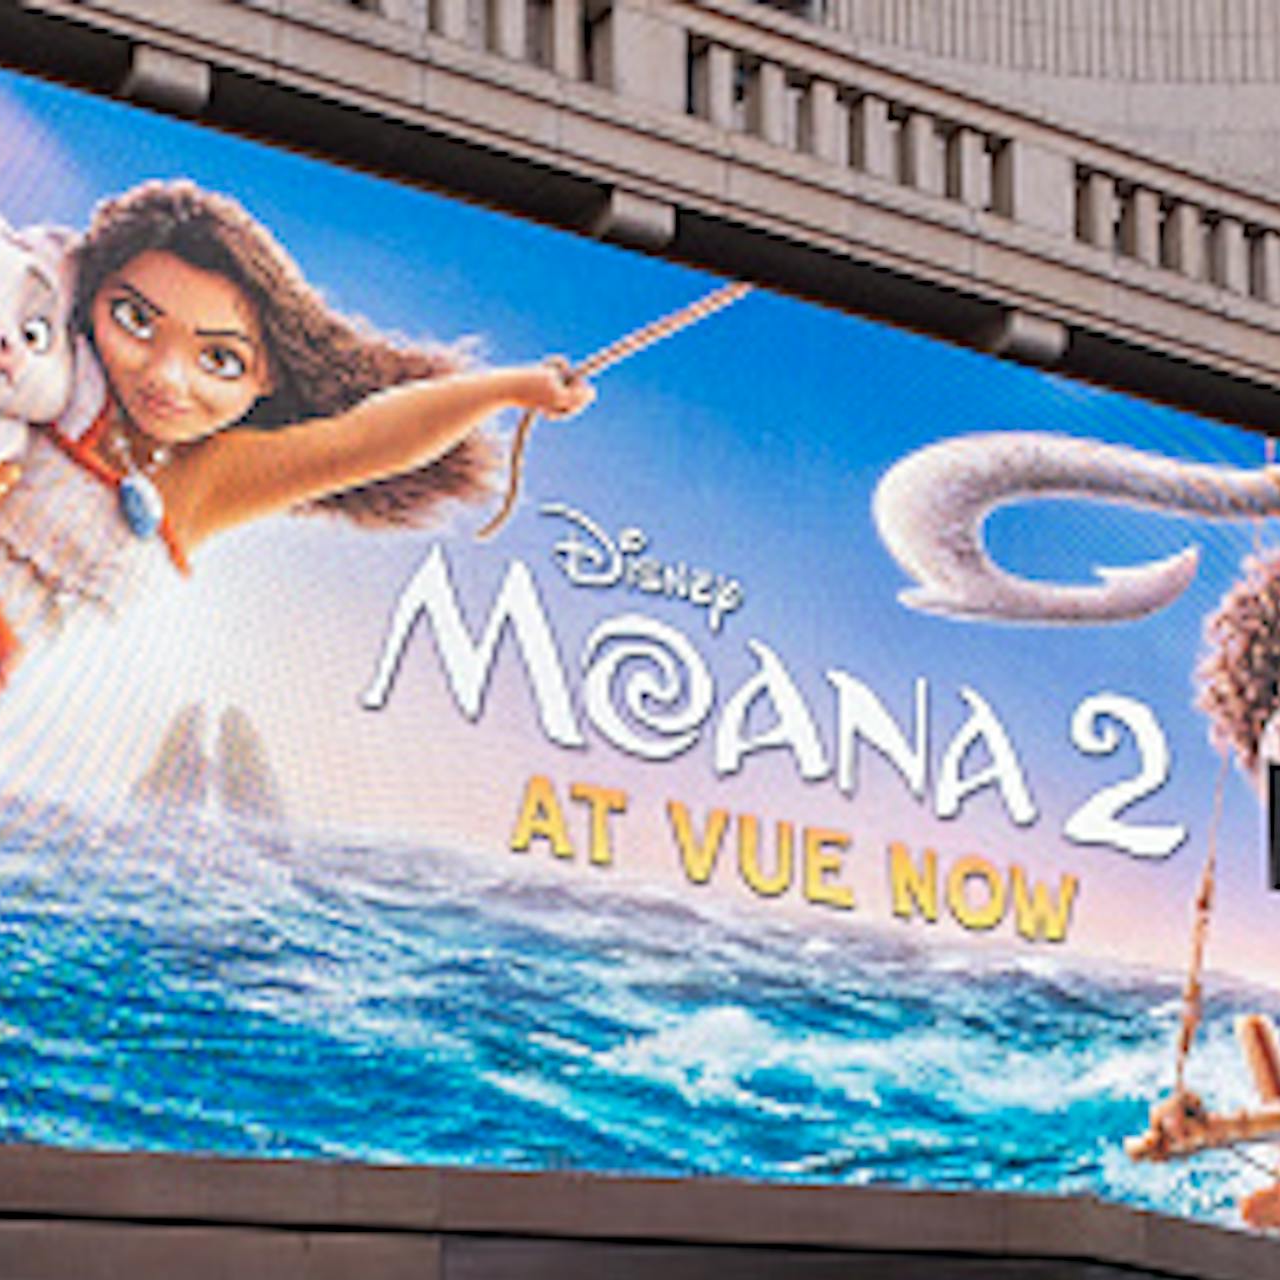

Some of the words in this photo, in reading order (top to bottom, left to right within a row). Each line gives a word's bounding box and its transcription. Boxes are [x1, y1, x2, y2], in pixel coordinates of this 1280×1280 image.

[539, 503, 743, 631] Disney
[361, 543, 1038, 828] MOANA
[1061, 691, 1188, 859] 2
[510, 774, 627, 866] AT
[666, 800, 857, 911] VUE
[887, 840, 1081, 943] NOW
